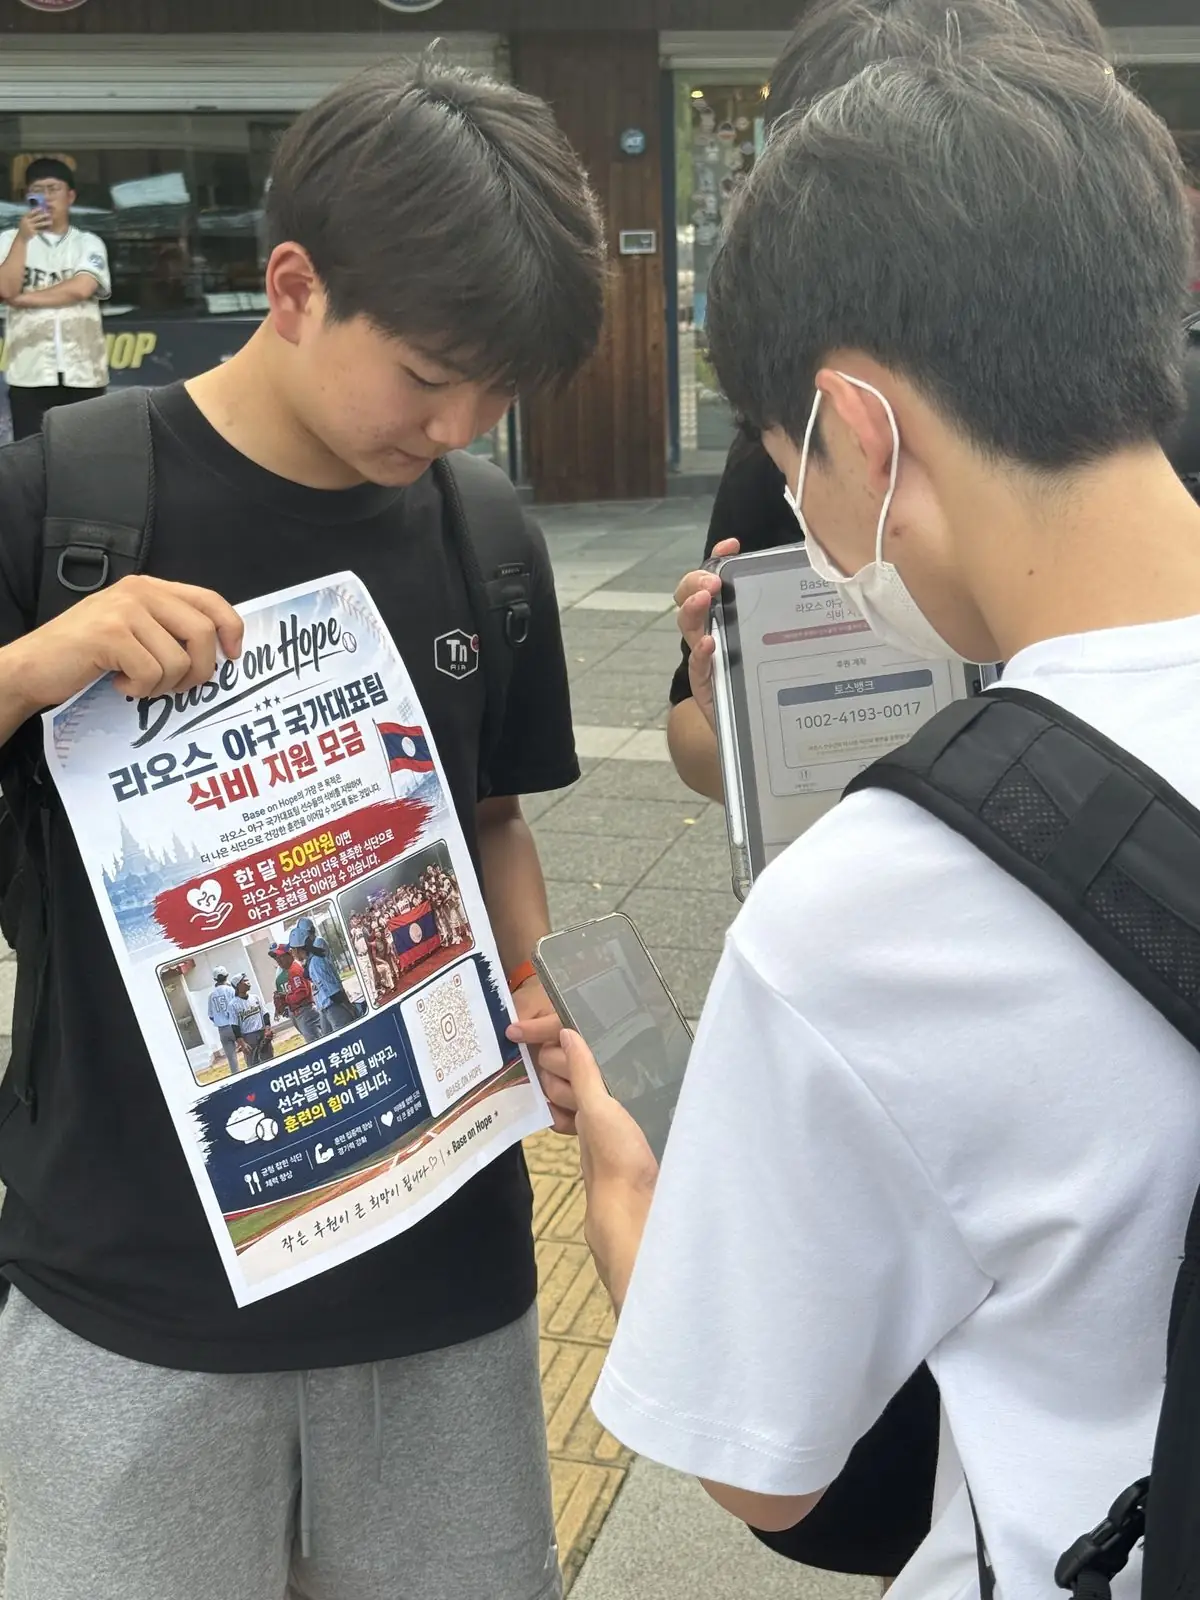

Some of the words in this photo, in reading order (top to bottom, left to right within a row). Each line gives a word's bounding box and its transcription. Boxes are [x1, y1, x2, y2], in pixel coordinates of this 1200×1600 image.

[795, 600, 823, 614] 라오스
[800, 578, 830, 591] Base
[243, 643, 275, 680] on
[278, 613, 342, 681] Hope
[446, 639, 468, 662] Tn
[833, 680, 875, 695] 토스뱅크
[108, 742, 218, 802] 라오스
[222, 715, 280, 761] 야구
[282, 672, 388, 736] 국가대표팀
[795, 701, 922, 730] 1002-4193-0017
[187, 764, 259, 811] 식비
[262, 741, 318, 788] 지원
[317, 720, 365, 767] 모금
[219, 828, 247, 843] 라오스
[247, 820, 264, 832] 야구
[266, 805, 300, 826] 국가대표팀
[301, 795, 324, 813] 선수들의
[324, 787, 341, 801] 식비를
[242, 808, 266, 822] Base
[267, 803, 278, 813] on
[278, 790, 304, 808] Hope의
[304, 785, 317, 797] 가장
[317, 781, 324, 791] 큰
[324, 773, 342, 787] 목적은
[200, 853, 211, 863] 더
[211, 847, 229, 860] 나은
[230, 834, 264, 853] 식단으로
[264, 825, 287, 841] 건강한
[287, 816, 307, 833] 훈련을
[306, 808, 325, 823] 이어갈
[325, 806, 330, 815] 수
[233, 868, 256, 891] 한
[257, 858, 278, 883] 달
[242, 885, 281, 906] 라오스
[281, 866, 321, 892] 선수단이
[322, 857, 340, 873] 더욱
[340, 844, 363, 867] 풍족한
[363, 828, 395, 849] 식단으로
[248, 904, 273, 922] 야구
[274, 888, 309, 912] 훈련을
[309, 873, 338, 897] 이어갈
[338, 869, 347, 883] 수
[347, 852, 381, 878] 있습니다.
[270, 1059, 327, 1094] 여러분의
[328, 1039, 366, 1070] 후원이
[277, 1079, 332, 1115] 선수들의
[332, 1061, 369, 1088] 식사를
[368, 1045, 398, 1069] 바꾸고,
[283, 1102, 327, 1135] 훈련의
[328, 1089, 355, 1113] 힘이
[355, 1071, 392, 1100] 됩니다.
[290, 1152, 303, 1163] 식단
[337, 1141, 355, 1155] 경기력
[451, 1134, 468, 1153] Base
[467, 1127, 477, 1140] on
[475, 1114, 493, 1133] Hope
[281, 1230, 309, 1253] 작은
[314, 1210, 350, 1238] 후원이
[354, 1202, 366, 1219] 큰
[369, 1185, 400, 1210] 희망이
